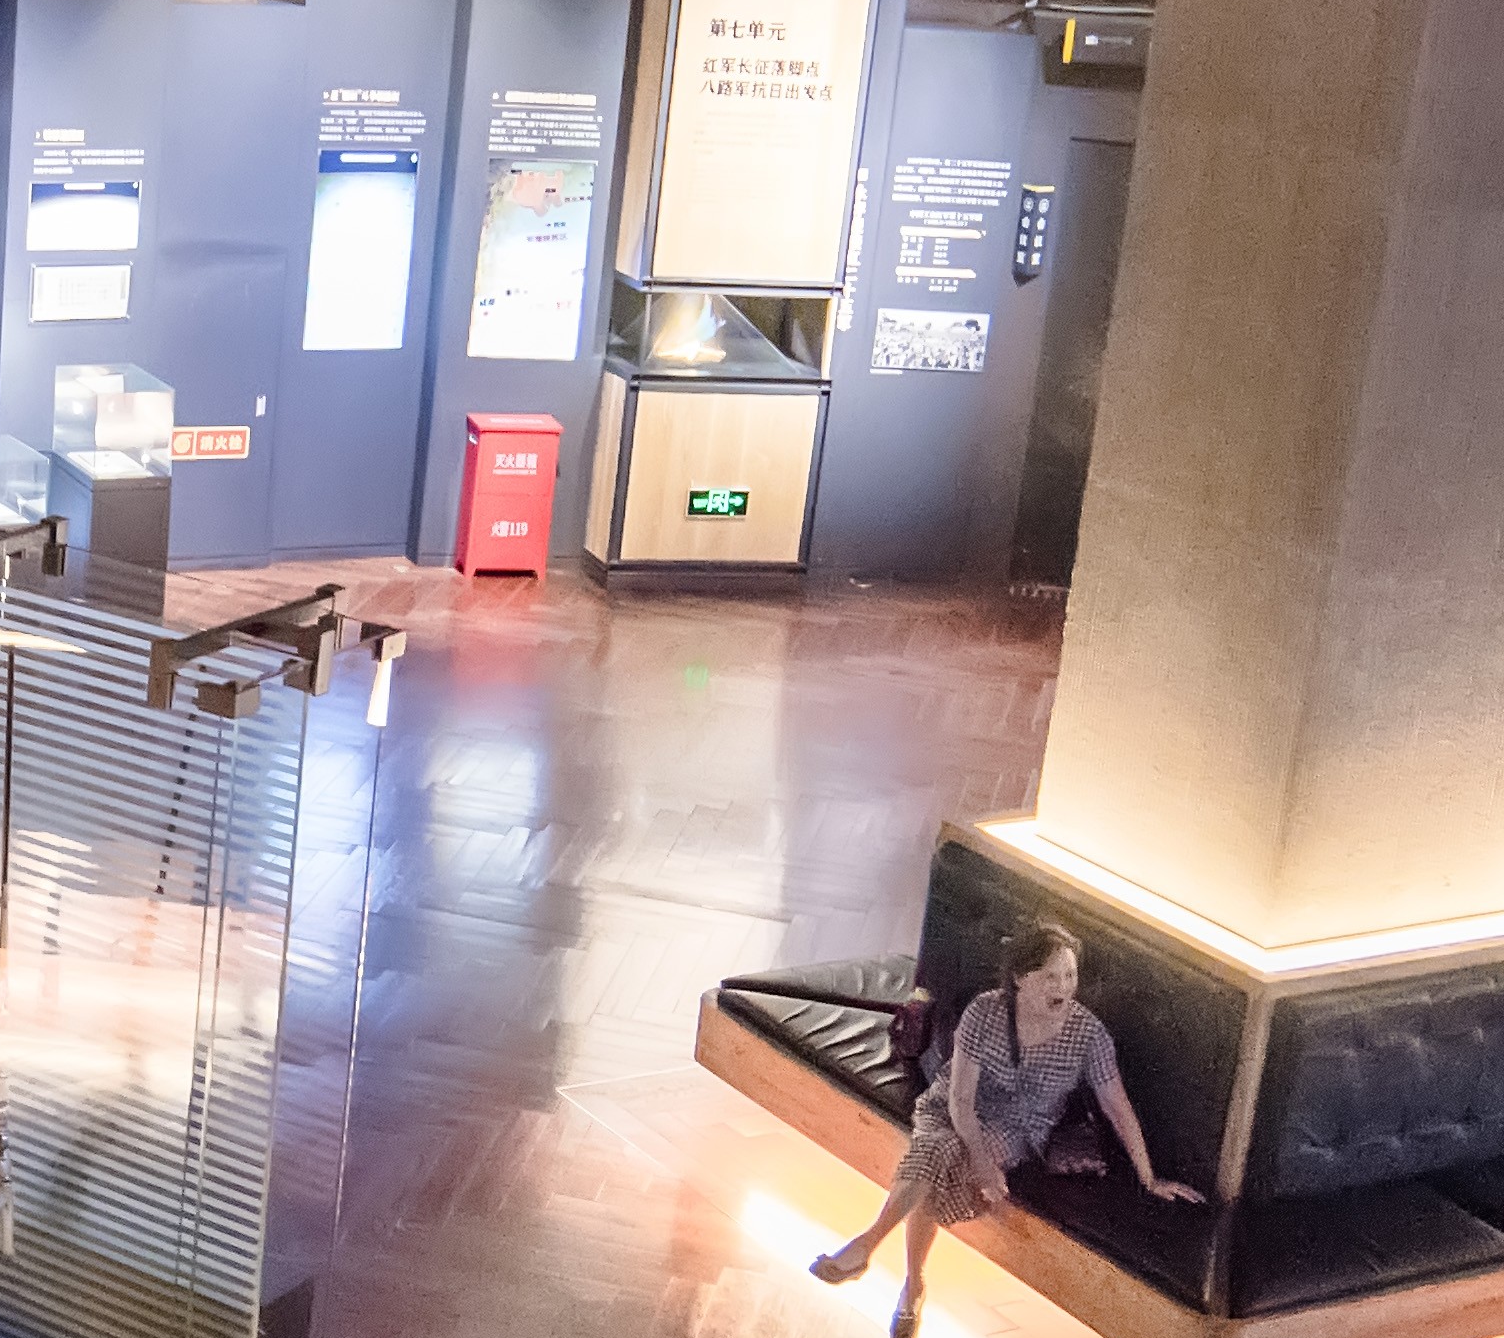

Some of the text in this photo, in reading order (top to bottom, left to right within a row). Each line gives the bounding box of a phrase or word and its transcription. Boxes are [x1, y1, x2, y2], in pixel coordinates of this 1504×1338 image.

[709, 18, 787, 41] 第七单元
[702, 56, 820, 78] 红军长征落脚点
[699, 79, 834, 103] 八路军抗日出发点
[200, 434, 244, 451] 消火栓
